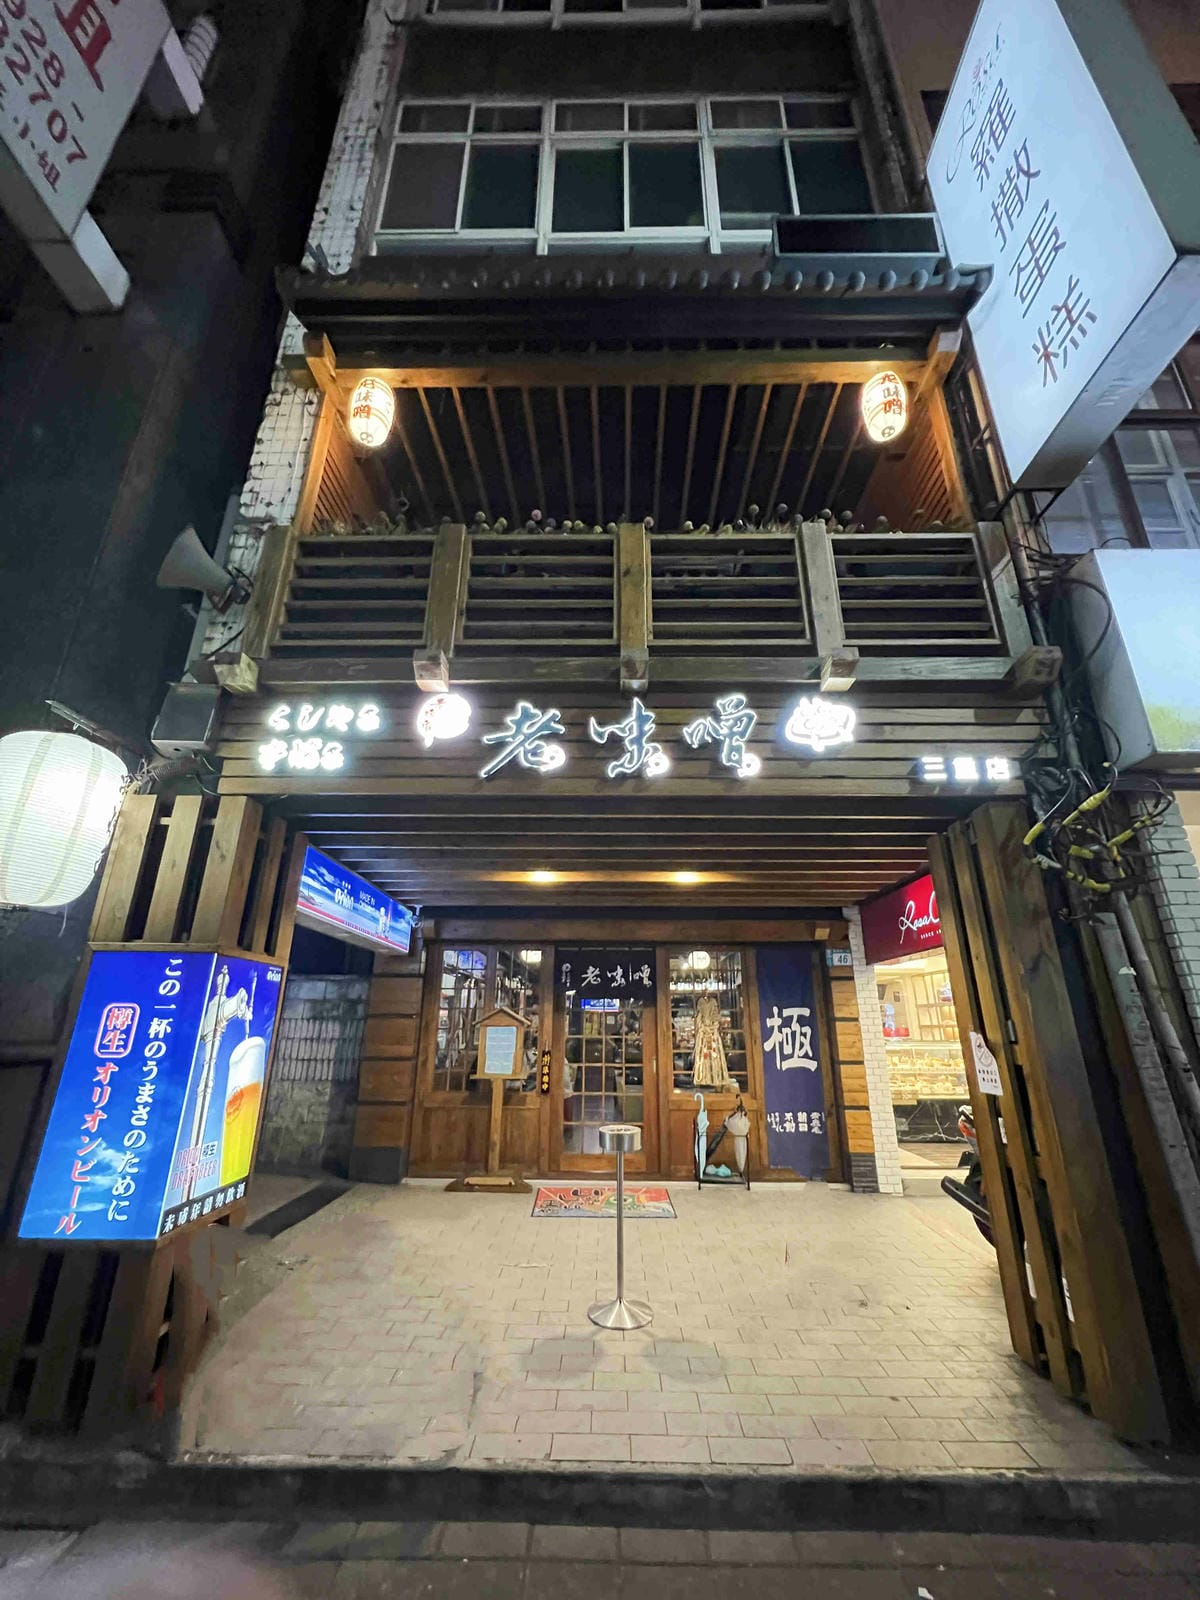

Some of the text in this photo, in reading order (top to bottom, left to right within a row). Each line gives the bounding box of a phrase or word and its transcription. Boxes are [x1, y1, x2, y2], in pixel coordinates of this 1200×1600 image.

[837, 954, 848, 964] 46
[107, 958, 184, 1222] この一杯のうまさのために
[763, 1006, 818, 1072] 極
[54, 1062, 119, 1236] オリオンビール
